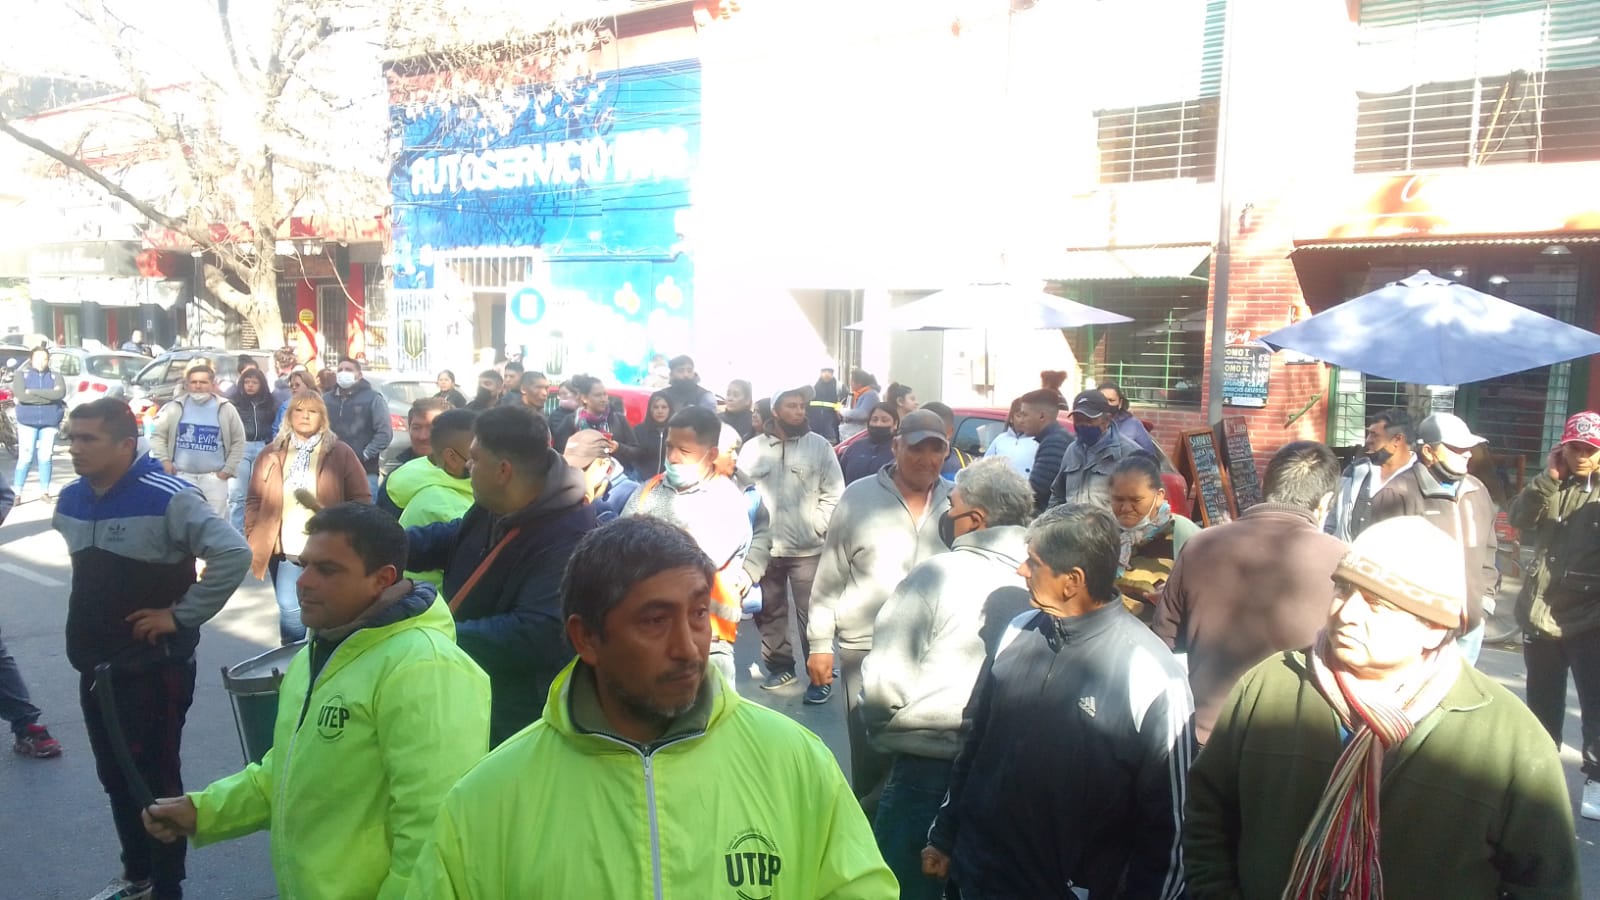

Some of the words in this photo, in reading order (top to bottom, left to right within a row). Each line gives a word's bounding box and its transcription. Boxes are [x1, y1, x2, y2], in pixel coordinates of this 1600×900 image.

[411, 136, 607, 195] AUTOSERVICIO
[191, 443, 217, 451] TALITAS
[317, 705, 350, 729] UTEP
[725, 852, 782, 887] UTEP
